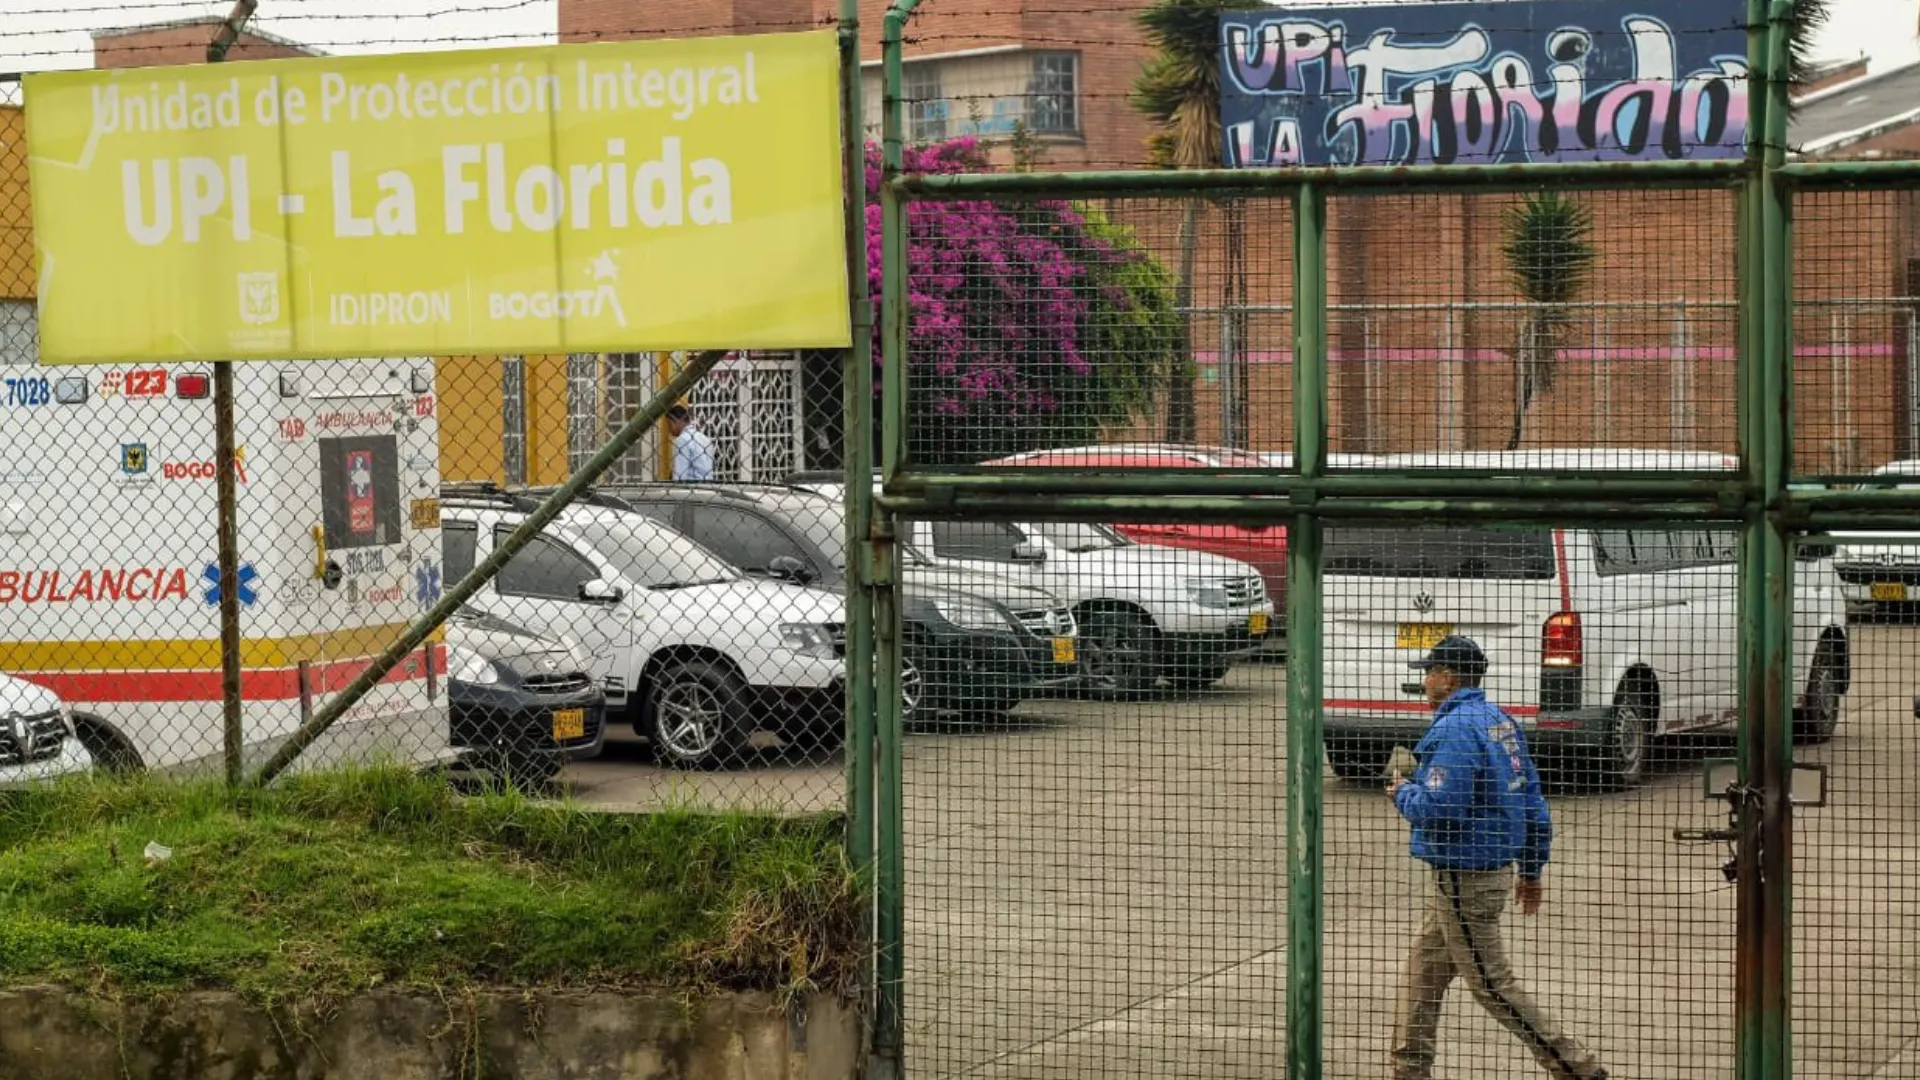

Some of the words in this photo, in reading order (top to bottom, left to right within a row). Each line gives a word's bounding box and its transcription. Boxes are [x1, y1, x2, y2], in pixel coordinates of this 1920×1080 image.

[92, 76, 240, 134] Unidad
[254, 75, 306, 126] de
[319, 61, 561, 122] Protección
[577, 51, 759, 121] Integral
[121, 154, 251, 246] UPI
[331, 150, 417, 237] La
[441, 136, 733, 234] Florida
[330, 290, 451, 325] IDIPRON
[5, 377, 51, 405] 7028
[125, 369, 167, 396] 123
